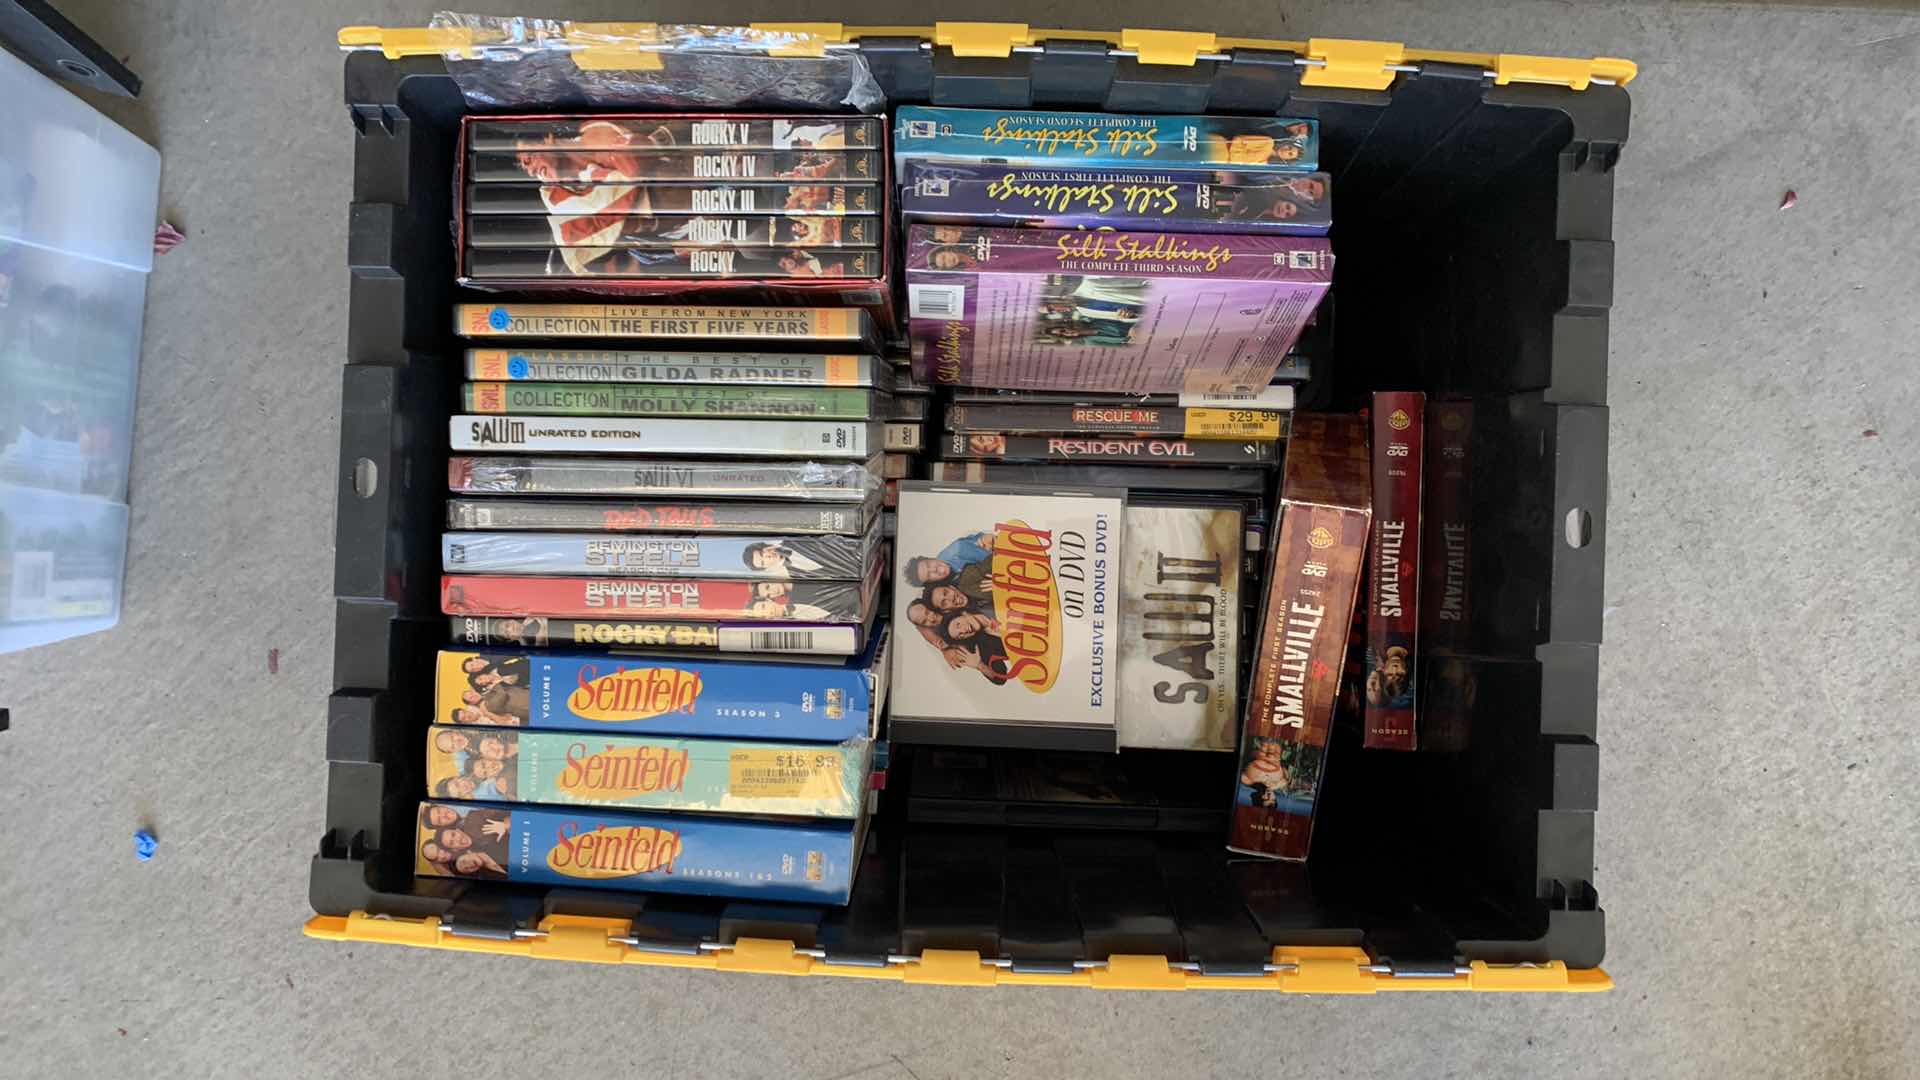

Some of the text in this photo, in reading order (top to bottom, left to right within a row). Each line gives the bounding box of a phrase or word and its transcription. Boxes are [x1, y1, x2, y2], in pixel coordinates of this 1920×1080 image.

[1009, 115, 1157, 127] THE COMPLETE SECOND SEASON
[692, 123, 749, 145] ROCKY V
[982, 117, 1158, 156] Silk Stalkings
[1188, 126, 1197, 151] DVD
[693, 155, 756, 177] ROCKY IV
[1022, 171, 1172, 184] THE COMPLETE FIRST SEASON
[692, 189, 755, 211] ROCKY III
[987, 173, 1179, 214] Silk Stalkings
[1201, 184, 1210, 210] DVD
[688, 220, 747, 241] ROCKY II
[977, 236, 986, 261] DVD
[1056, 234, 1232, 271] Silk Stalkings
[690, 251, 735, 272] ROCKY
[1061, 261, 1202, 273] THE COMPLETE THIRD SEASON
[472, 307, 490, 333] SNL
[611, 308, 807, 318] LIVE FROM NEW YORK
[504, 318, 601, 334] COLLECTION
[610, 320, 642, 333] THE
[651, 320, 699, 334] FIRST
[708, 320, 745, 334] FIVE
[754, 321, 809, 335] YEARS
[484, 351, 500, 378] SNL
[619, 354, 807, 366] THE BEST OF
[528, 364, 612, 380] OLLECTION
[622, 366, 813, 381] GILDA RADNER
[481, 384, 499, 410] SNL
[513, 391, 610, 408] COLLECTION
[622, 400, 816, 414] MOLLY SHANNON
[1076, 410, 1160, 423] RESCUE ME
[1229, 411, 1279, 423] $29.99
[472, 418, 509, 446] SAW
[529, 429, 641, 439] UNRATED EDITION
[952, 434, 960, 453] DVD
[1048, 438, 1194, 458] RESIDENT EVIL
[634, 465, 670, 489] SAW
[712, 472, 766, 482] UNRATED
[602, 507, 652, 529] RED
[585, 540, 700, 552] REMINGTON
[584, 550, 700, 567] STEELE
[1380, 520, 1405, 617] SMALLVILLE
[1058, 529, 1087, 619] on DVD
[584, 592, 700, 608] STEELE
[585, 583, 700, 597] REMINGTON
[991, 522, 1053, 686] Seinfeld
[1090, 513, 1109, 708] EXCLUSIVE BONUS DVD!
[465, 618, 474, 643] DVD
[574, 624, 672, 645] ROCKY
[1142, 592, 1215, 705] SAW
[1261, 600, 1287, 722] THE COMPLETE FIRST SEASON
[1272, 601, 1325, 729] SMALLVILLE
[542, 664, 551, 719] VOLUME 2
[574, 664, 701, 715] Seinfeld
[801, 691, 811, 713] DVD
[716, 708, 781, 719] SEASON 3
[1371, 727, 1409, 736] SEASON
[562, 743, 689, 793] Seinfeld
[1250, 823, 1290, 835] SEASON
[521, 832, 530, 874] VOLUME
[553, 820, 680, 874] Seinfeld
[682, 869, 740, 880] SEASONS
